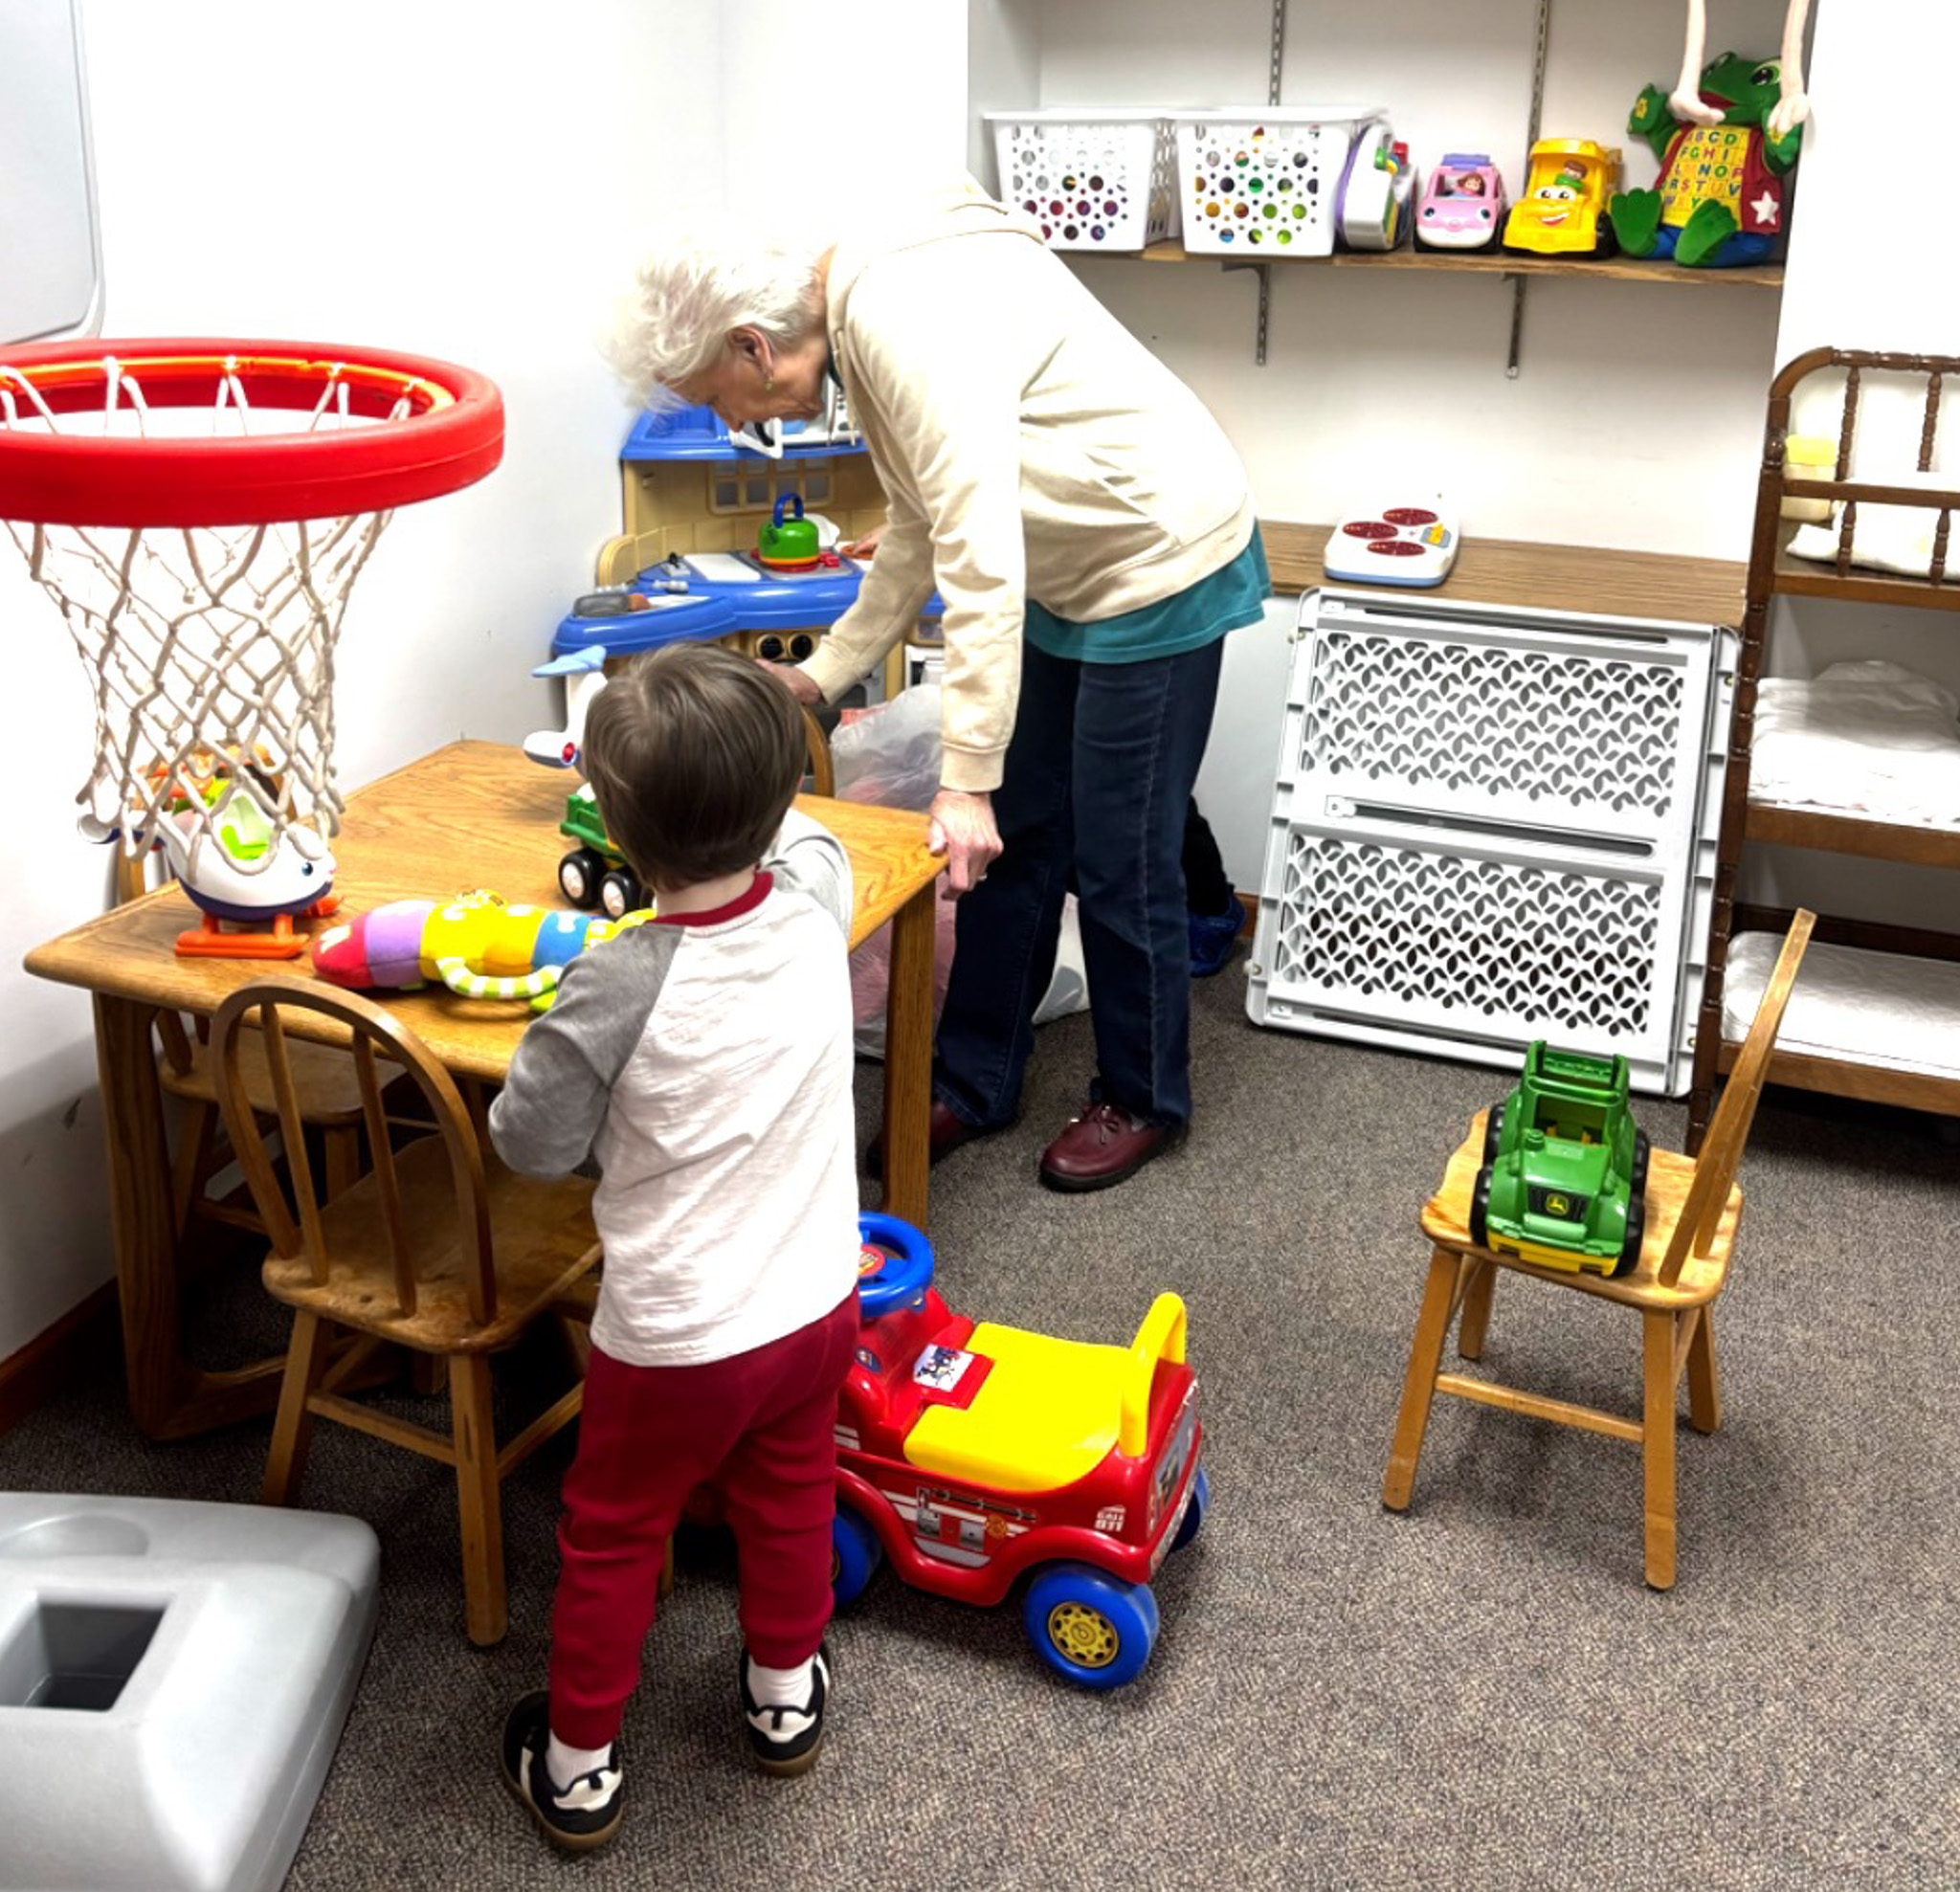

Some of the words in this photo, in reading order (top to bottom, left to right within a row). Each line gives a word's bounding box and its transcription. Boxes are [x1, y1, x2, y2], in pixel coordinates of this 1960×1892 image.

[1725, 133, 1737, 145] D
[1714, 165, 1726, 178] O
[1696, 180, 1707, 191] T
[1729, 183, 1741, 195] V
[1094, 1519, 1123, 1532] 911
